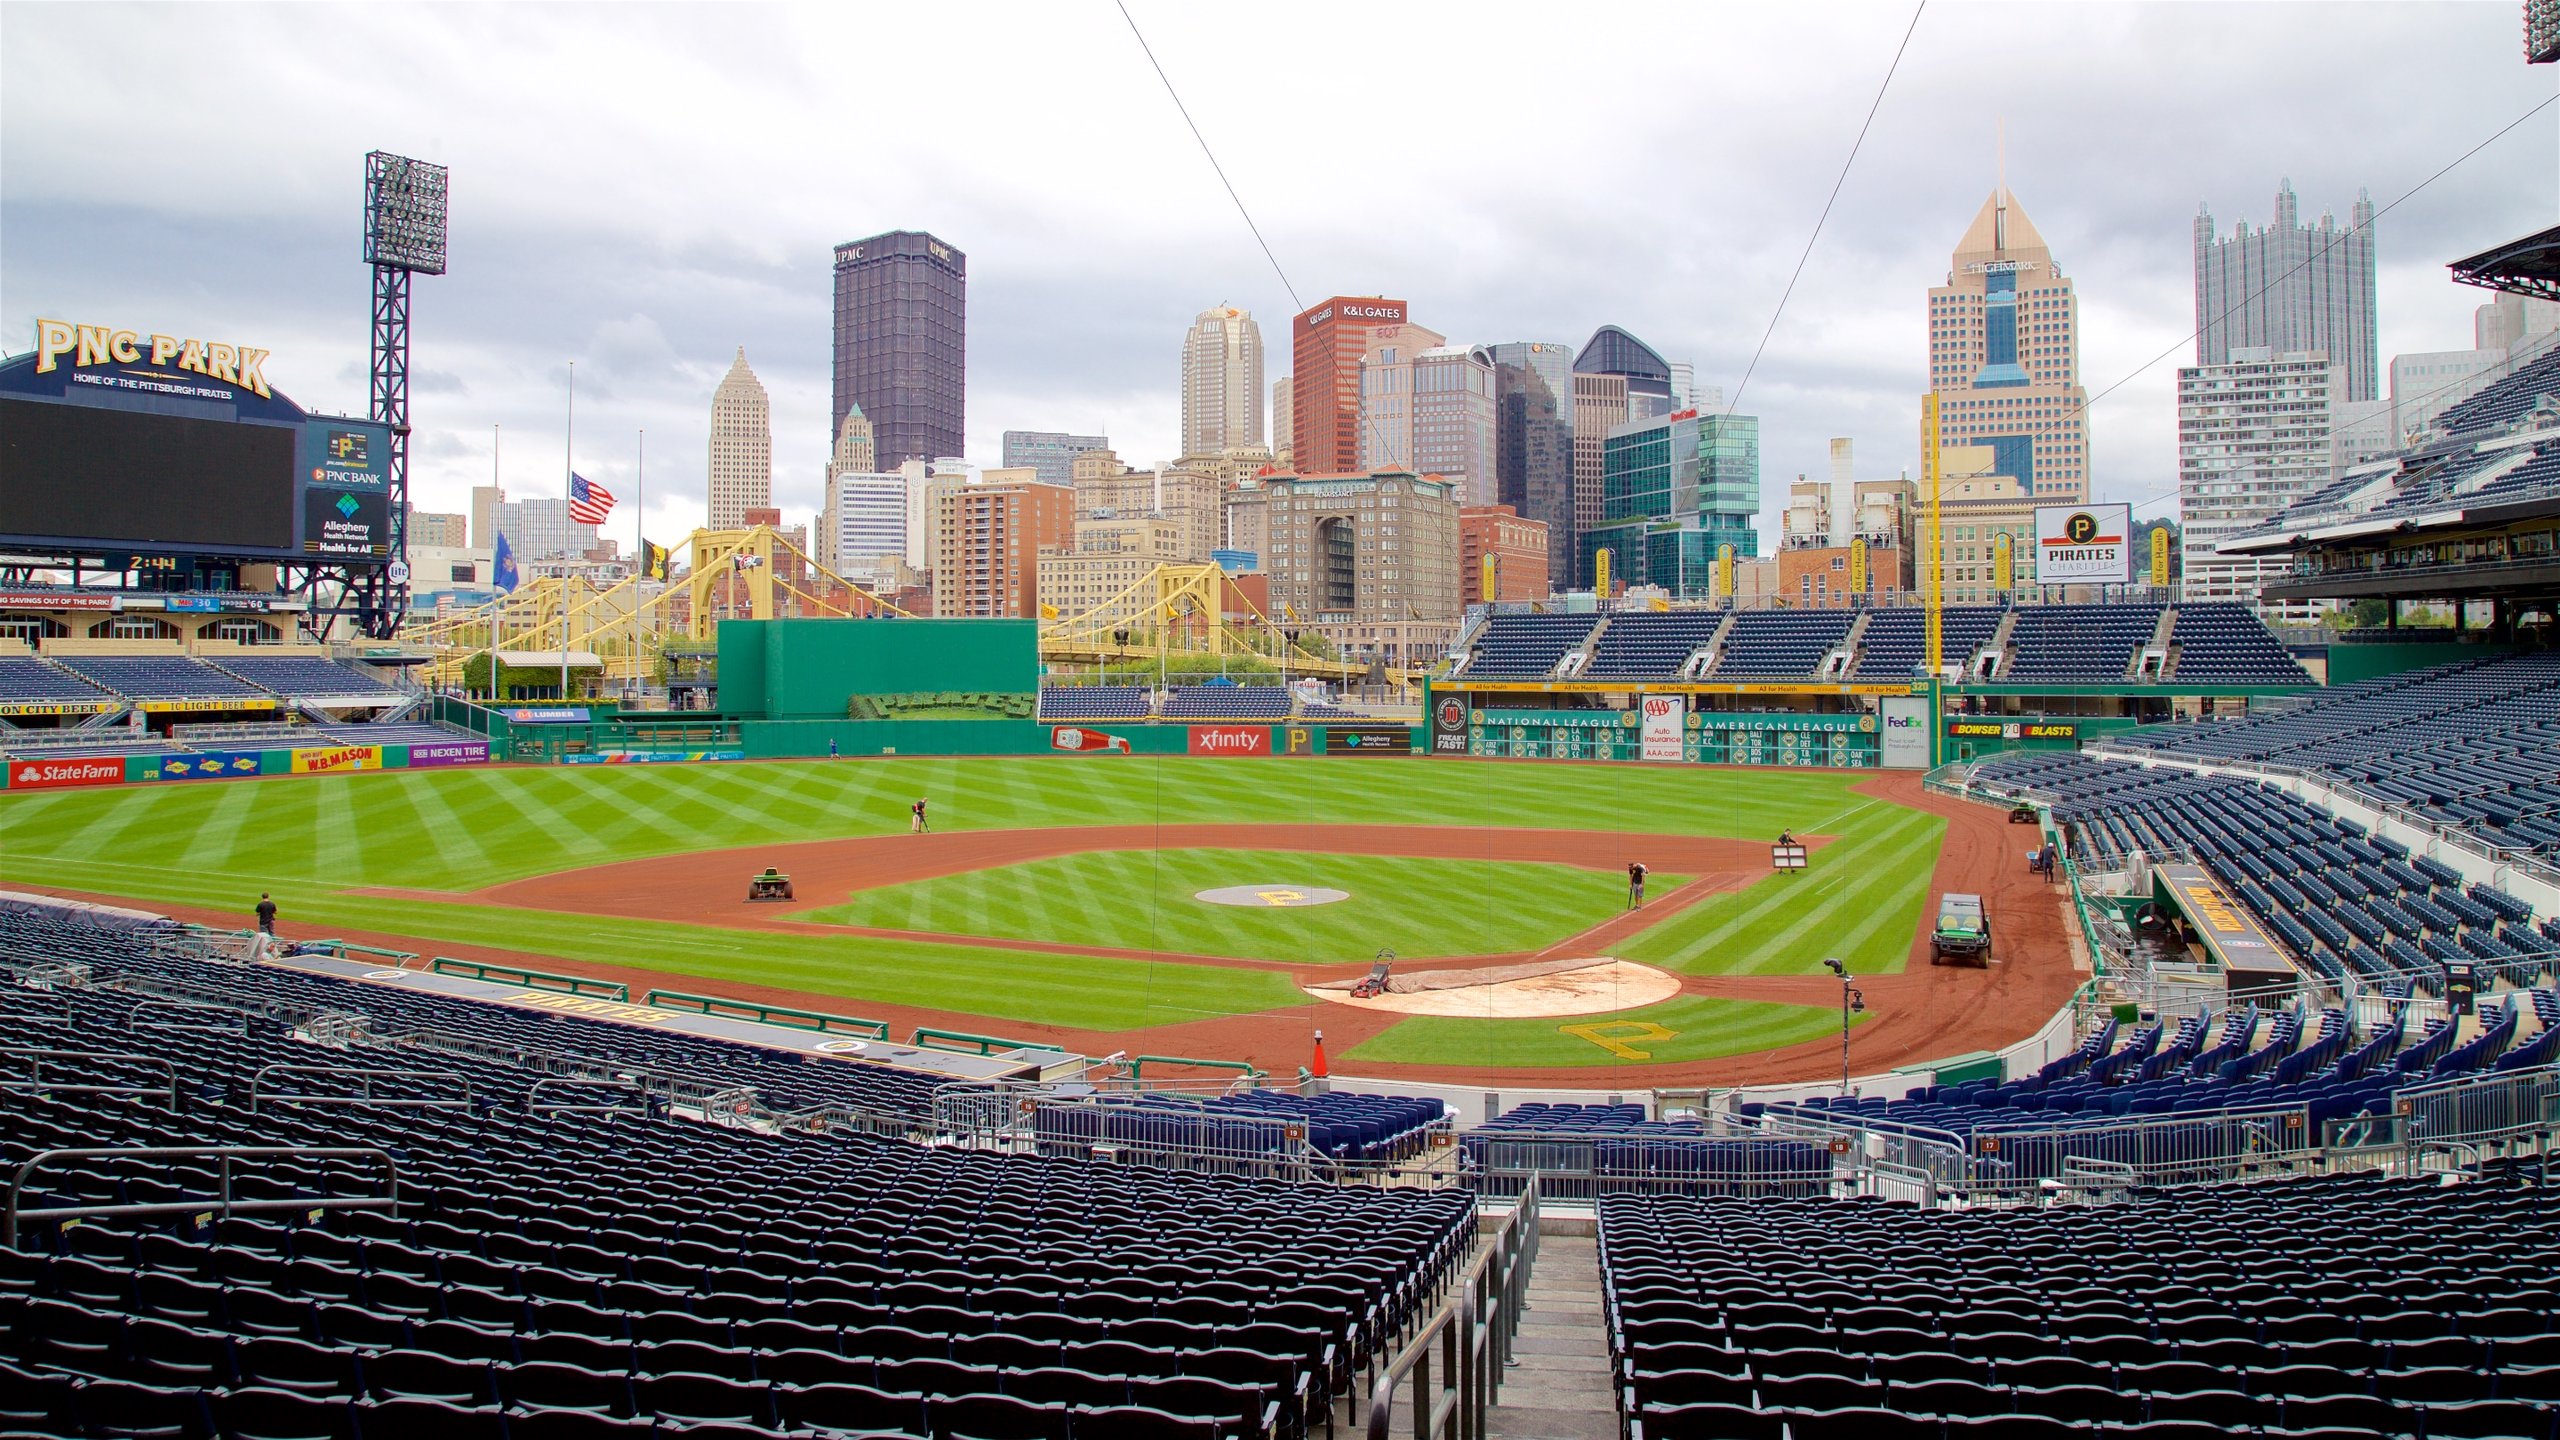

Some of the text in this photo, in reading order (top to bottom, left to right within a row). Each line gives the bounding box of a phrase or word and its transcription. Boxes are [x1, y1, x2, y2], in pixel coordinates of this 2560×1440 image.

[930, 242, 951, 262] UPMC
[1973, 261, 2035, 274] HIGHMARK
[1343, 306, 1400, 319] K&L GATES
[1376, 327, 1400, 339] EQT
[1541, 344, 1559, 353] PNC
[36, 319, 272, 400] PNC PARK
[73, 373, 233, 400] HOME OF THE PITTSBURGH PIRATES
[327, 470, 381, 485] PNC BANK
[324, 521, 370, 533] Allegheny
[2075, 519, 2090, 539] P
[320, 543, 372, 553] Health for All
[2049, 548, 2115, 561] PIRATES
[2155, 532, 2164, 584] All for Health
[130, 556, 176, 570] 2:44
[2049, 561, 2116, 572] CHARITIES
[391, 565, 408, 576] Lite
[1854, 571, 1862, 581] for
[1854, 582, 1862, 591] All
[88, 598, 110, 606] PARK!
[1911, 682, 1929, 691] 320
[27, 705, 59, 714] CITY
[63, 705, 98, 714] BEER
[170, 701, 246, 710] IC LIGHT BEER
[1646, 700, 1669, 716] AAA
[534, 710, 574, 718] LUMBER
[1445, 706, 1458, 722] JJ
[1487, 718, 1618, 727] NATIONAL LEAGUE
[1704, 721, 1856, 731] AMERICAN LEAGUE
[1888, 716, 1922, 728] FedEx
[1800, 731, 1811, 739] CLE
[1958, 725, 2002, 735] BOWSER
[2031, 726, 2073, 736] BLASTS
[1200, 730, 1260, 750] xfinity
[1290, 729, 1307, 752] P
[1362, 735, 1390, 744] Allegheny
[1645, 735, 1681, 743] Insurance
[1751, 739, 1762, 747] TOR
[1800, 740, 1810, 748] DET
[1437, 740, 1465, 750] FAST!
[430, 748, 462, 758] NEXEN
[464, 746, 485, 756] TIRE
[1646, 750, 1681, 758] AAA.com
[1850, 751, 1863, 759] OAK
[1800, 758, 1811, 766] CWS
[1851, 759, 1863, 767] SEA
[503, 992, 681, 1023] PIRATES
[1558, 1019, 1680, 1059] P
[1289, 1129, 1298, 1137] 19
